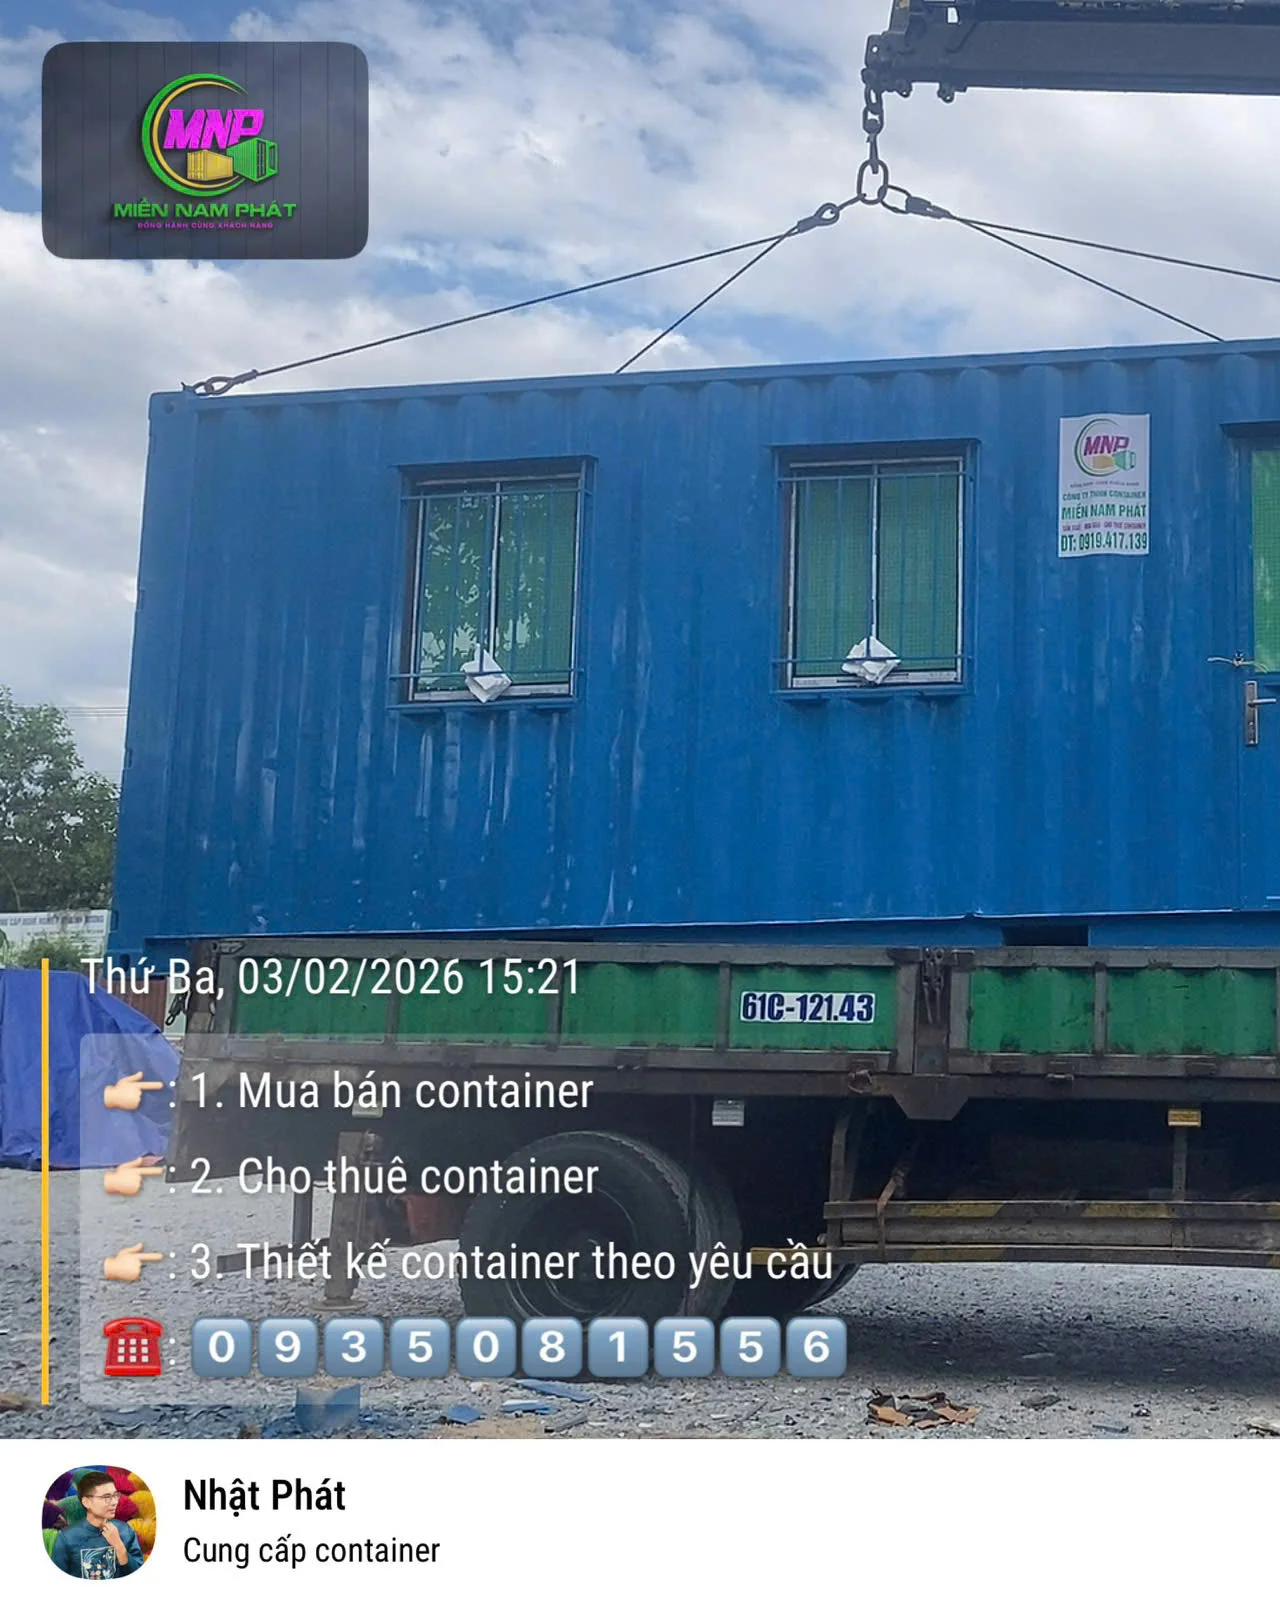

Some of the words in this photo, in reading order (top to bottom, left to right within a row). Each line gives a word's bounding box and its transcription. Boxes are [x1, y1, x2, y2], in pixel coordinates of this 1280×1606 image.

[1084, 435, 1129, 456] MNP
[1090, 504, 1115, 517] NAM
[1079, 532, 1147, 550] 0919.417.139
[742, 993, 874, 1021] 61C-121.43
